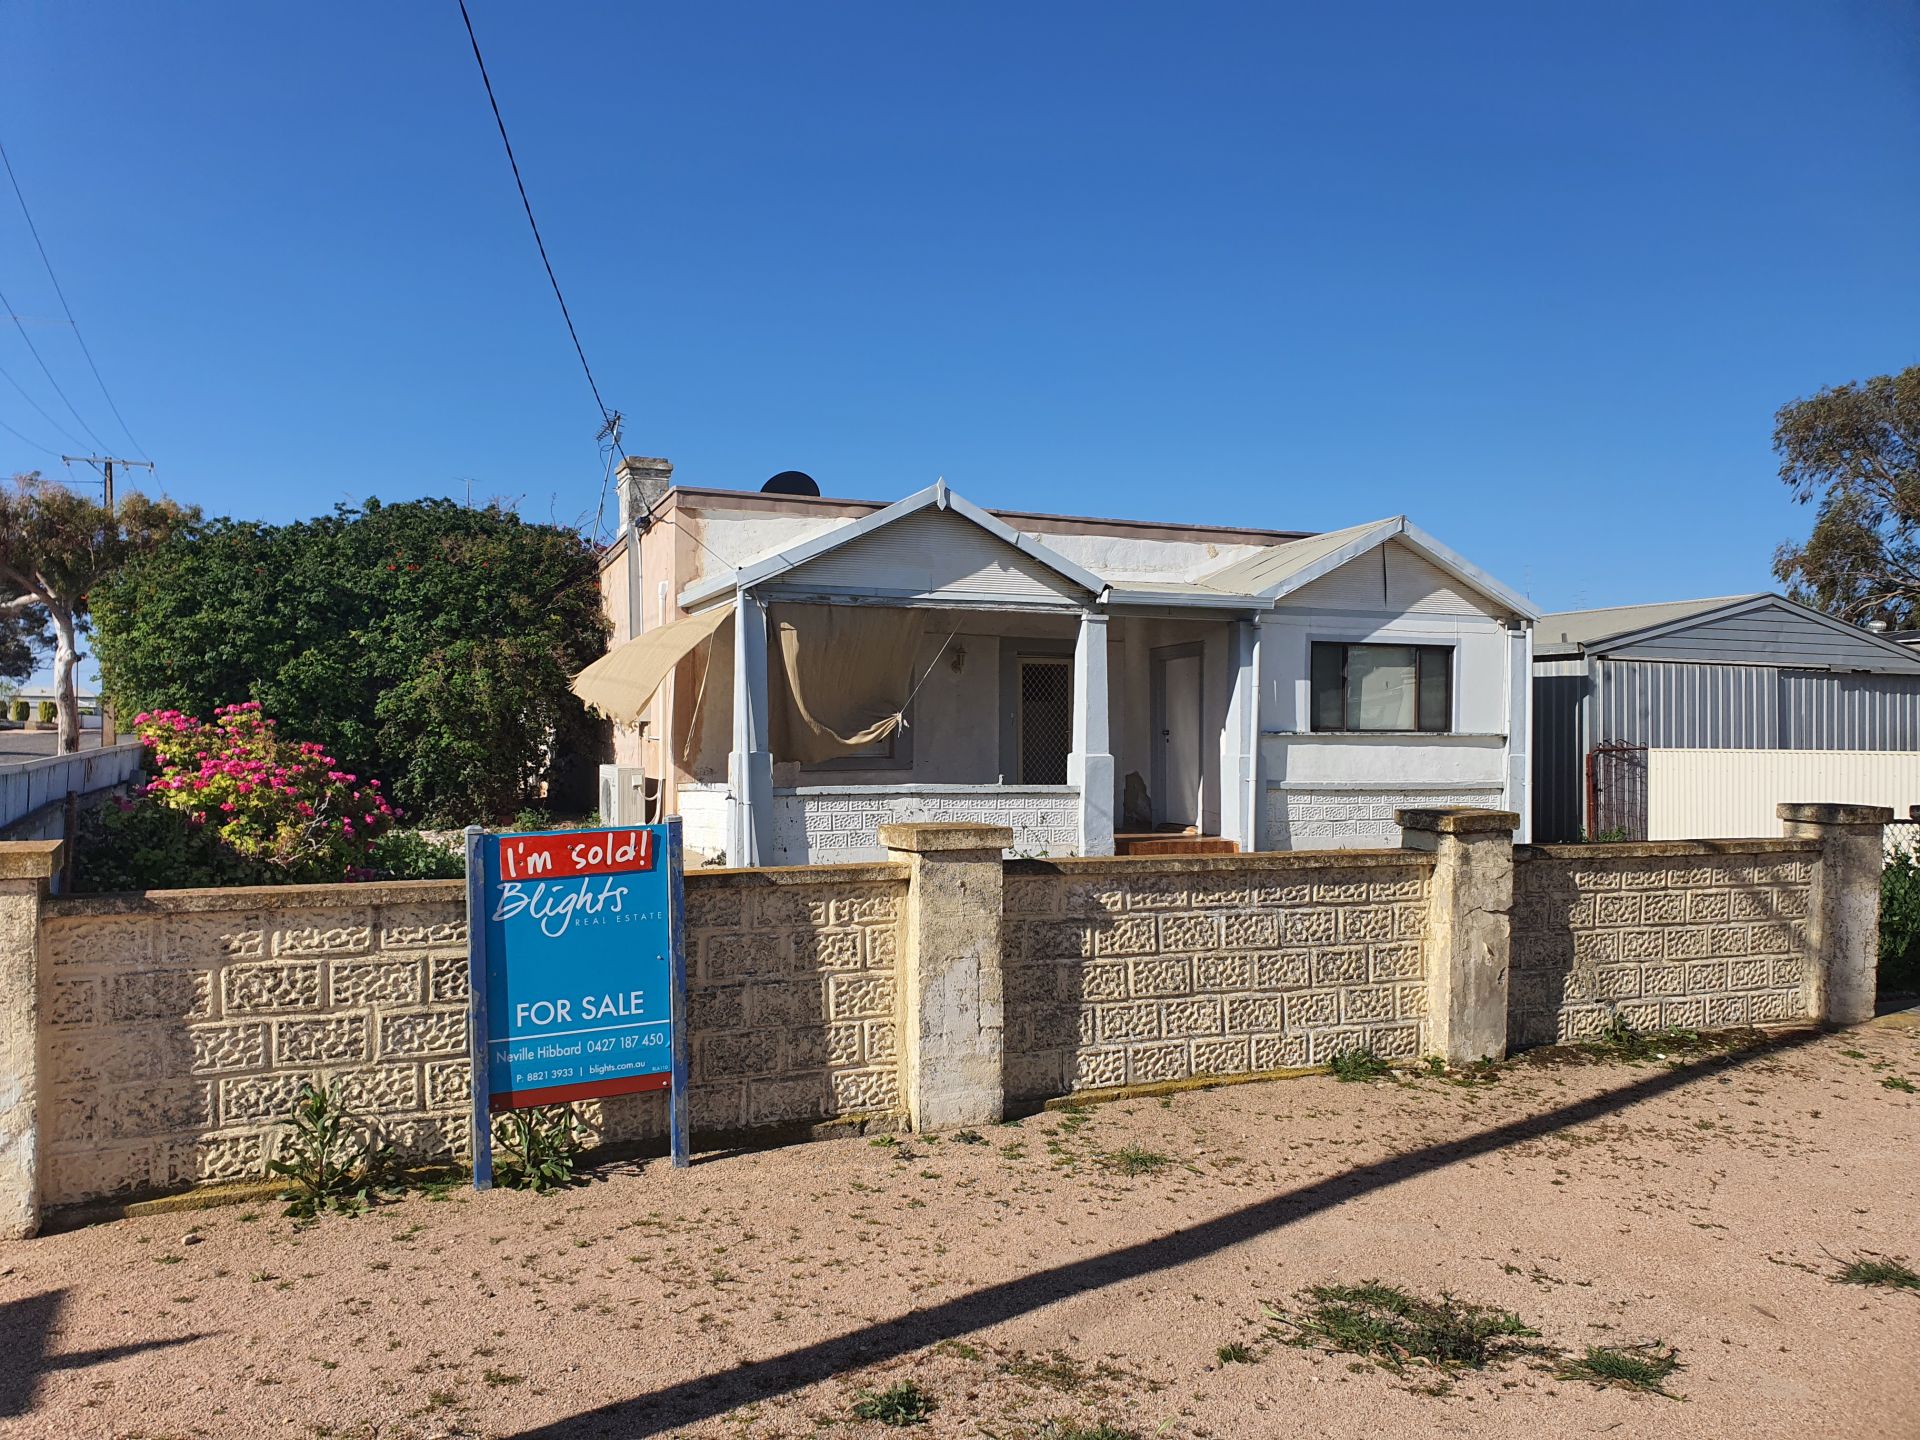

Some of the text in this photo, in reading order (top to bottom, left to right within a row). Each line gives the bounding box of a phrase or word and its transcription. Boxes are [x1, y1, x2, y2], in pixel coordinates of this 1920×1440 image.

[507, 830, 648, 878] I'm sold!
[491, 876, 628, 938] Blights
[575, 911, 662, 926] REAL ESTATE
[516, 990, 644, 1028] FOR SALE
[496, 1032, 664, 1064] Neville Hibbard 0427 187 450
[516, 1060, 646, 1083] P: 8821 3933 blights.com.au
